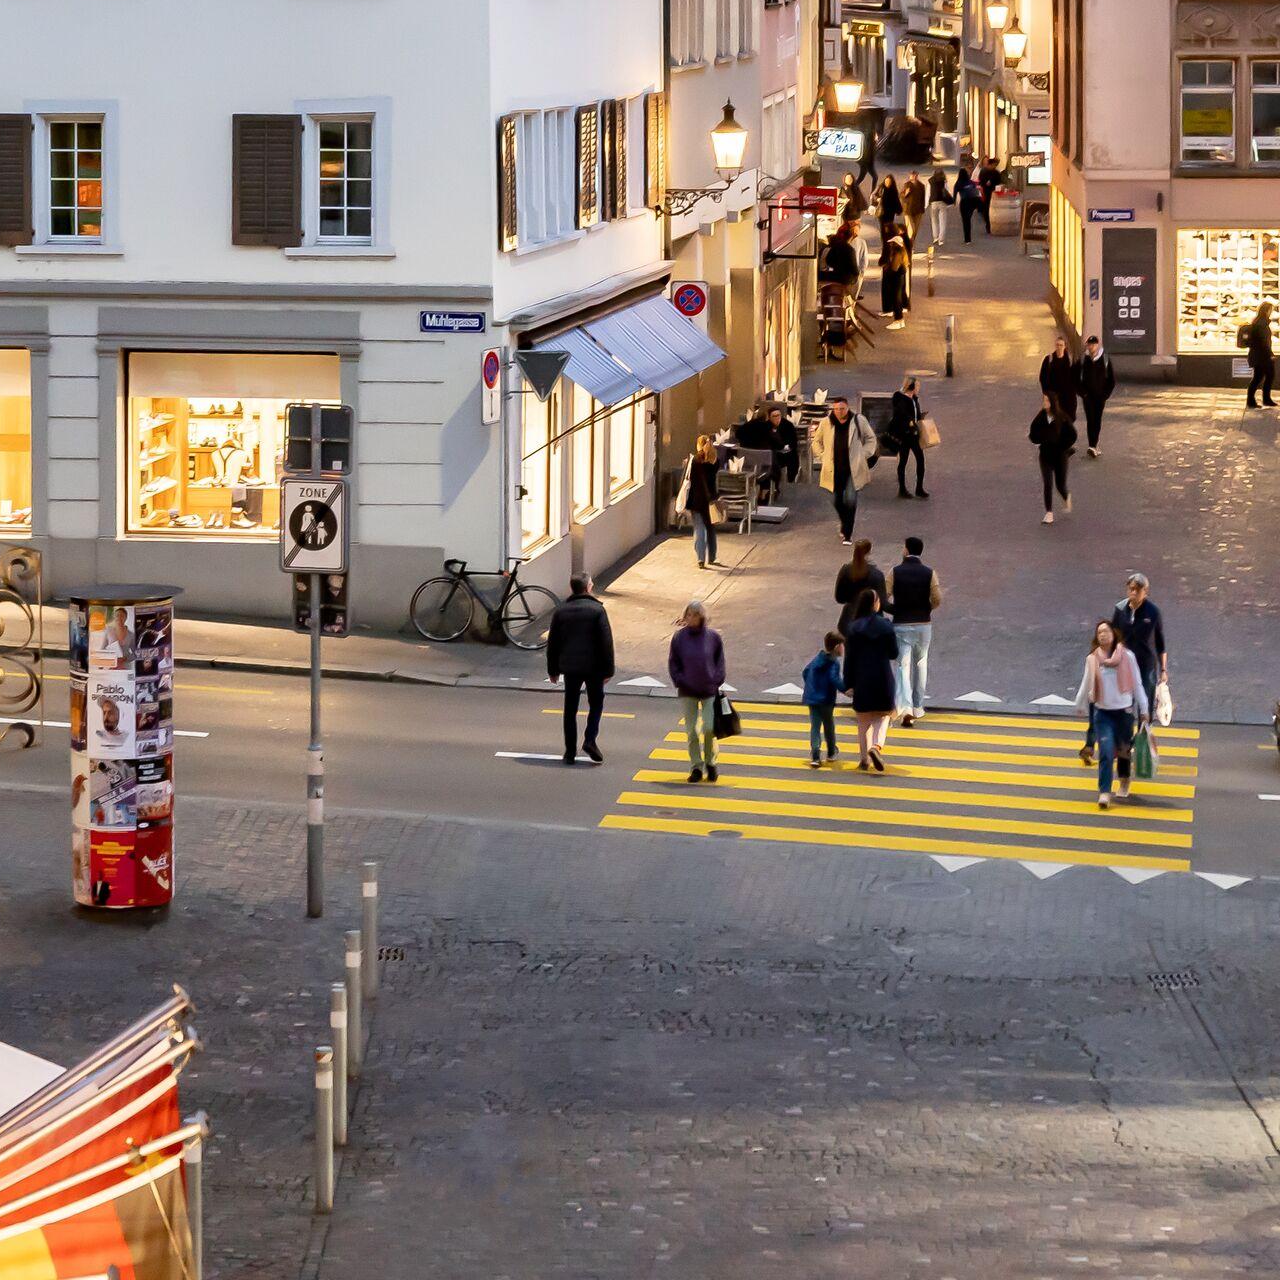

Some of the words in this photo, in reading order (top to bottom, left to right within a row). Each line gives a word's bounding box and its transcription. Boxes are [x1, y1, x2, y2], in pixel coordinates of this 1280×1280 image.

[835, 144, 857, 153] BAR
[425, 313, 480, 330] Mühlegasse
[299, 487, 328, 498] ZONE
[96, 683, 125, 695] Pablo
